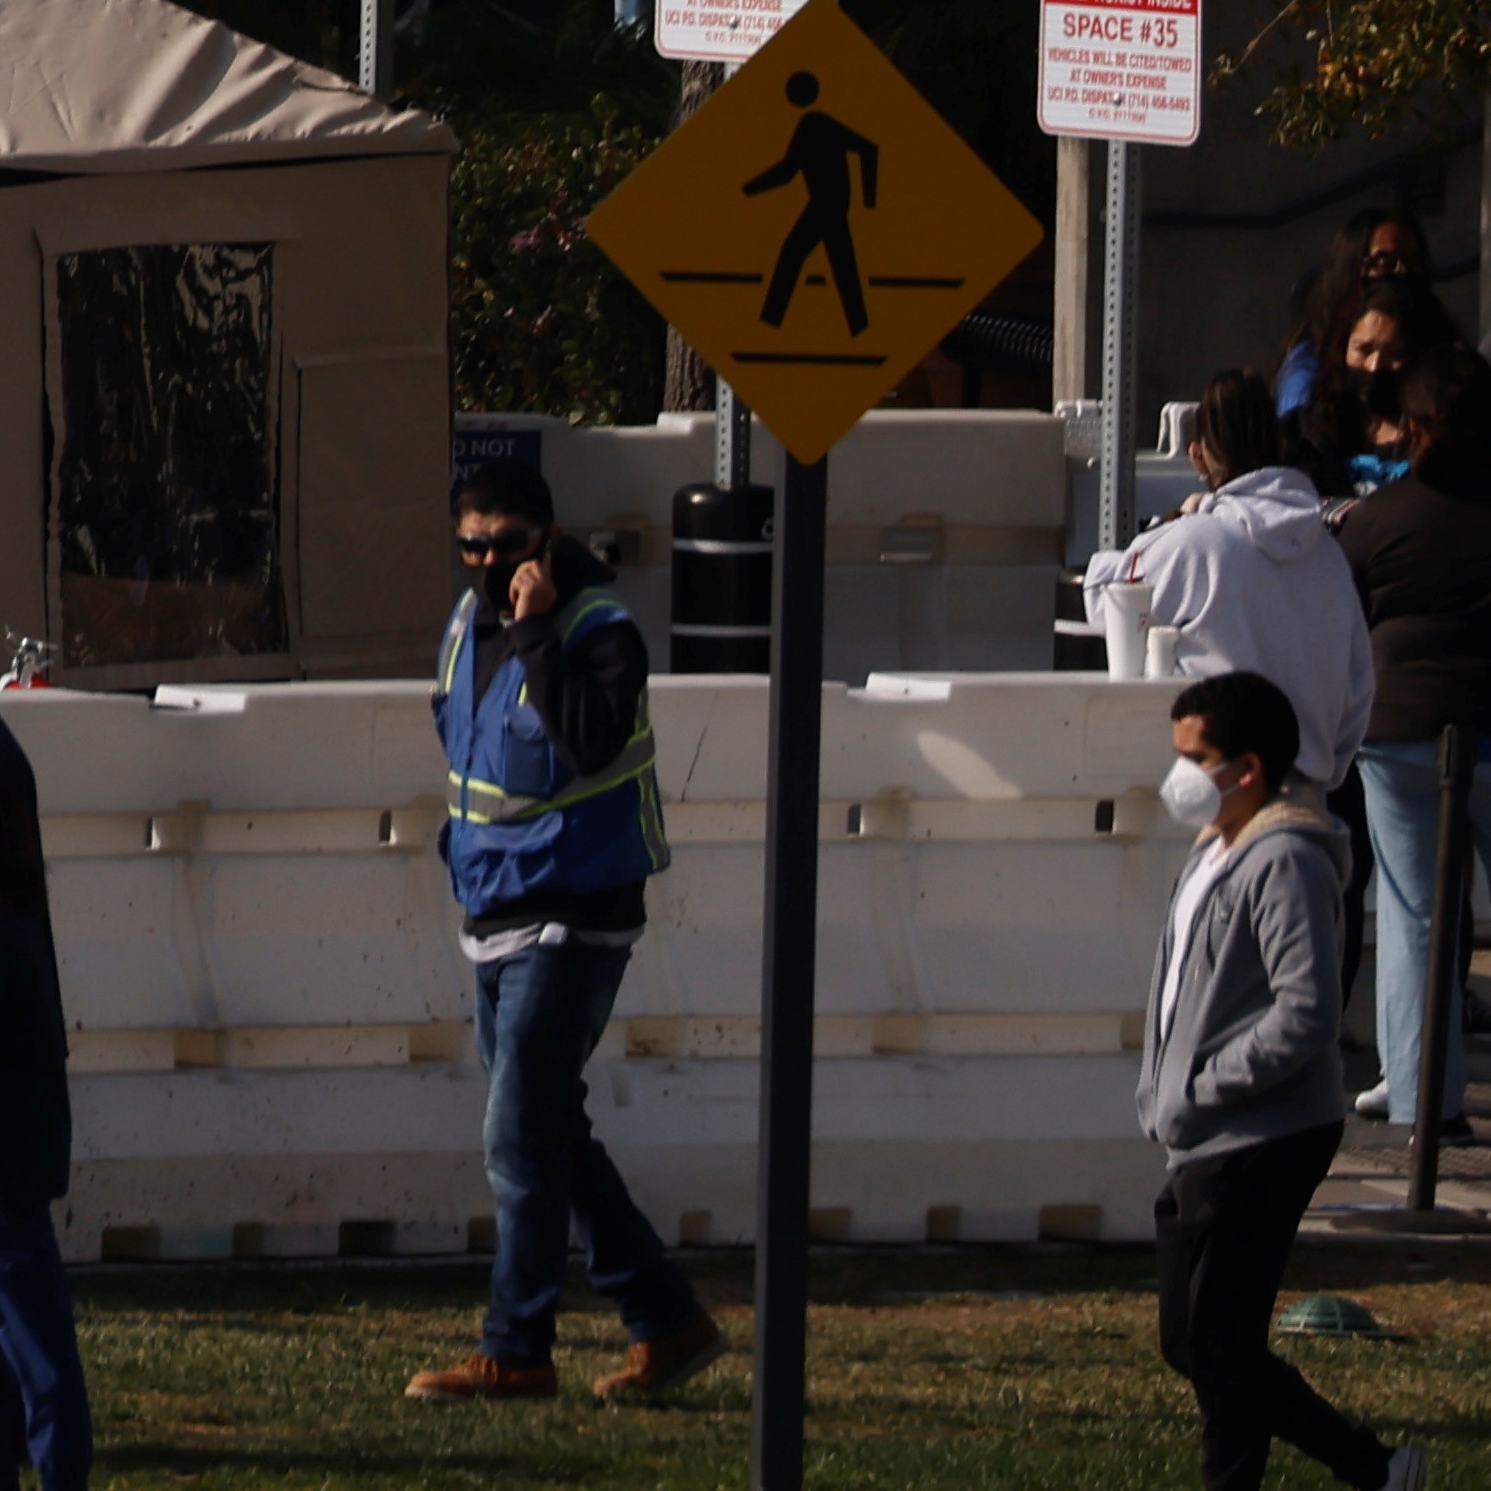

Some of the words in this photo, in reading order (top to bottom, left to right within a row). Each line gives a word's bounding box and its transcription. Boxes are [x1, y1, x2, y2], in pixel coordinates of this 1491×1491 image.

[1063, 12, 1133, 42] SPACE
[1140, 17, 1179, 49] #35
[1048, 47, 1090, 64] VEHICLES
[1092, 50, 1113, 66] WILL
[1115, 52, 1127, 68] BE
[1070, 68, 1081, 83] AT
[1126, 73, 1167, 90] EXPENSE
[471, 438, 516, 457] NOT
